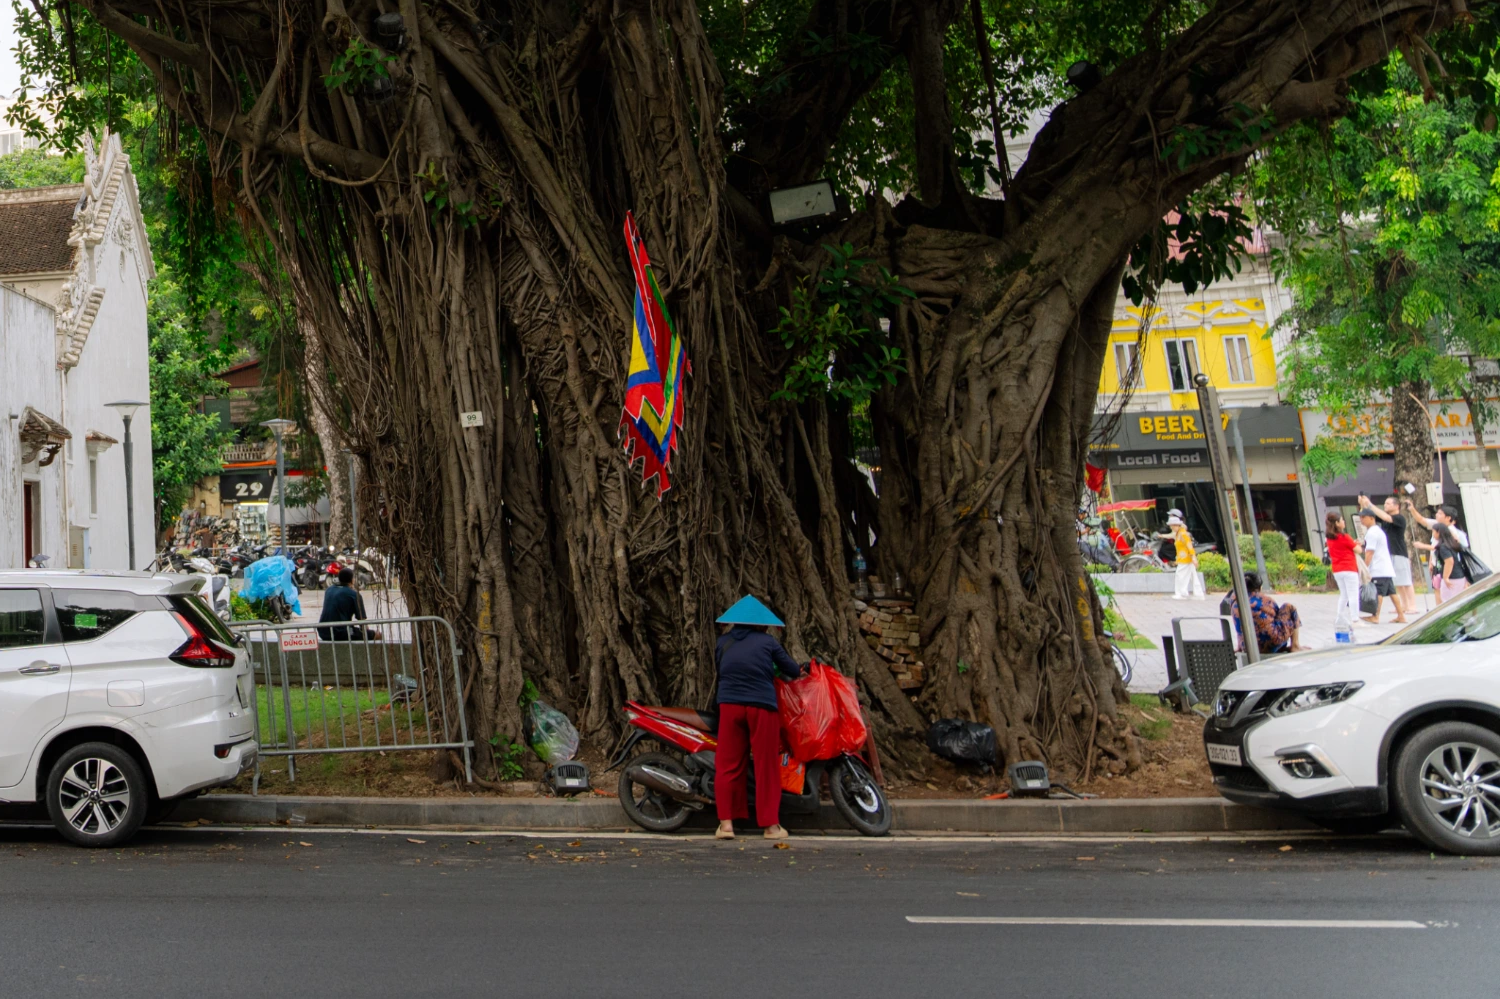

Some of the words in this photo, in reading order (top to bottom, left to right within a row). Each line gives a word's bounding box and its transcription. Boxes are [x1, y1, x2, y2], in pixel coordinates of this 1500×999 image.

[1139, 415, 1198, 434] BEER
[1117, 453, 1158, 466] Local
[1161, 452, 1201, 465] Food
[235, 482, 264, 497] 29
